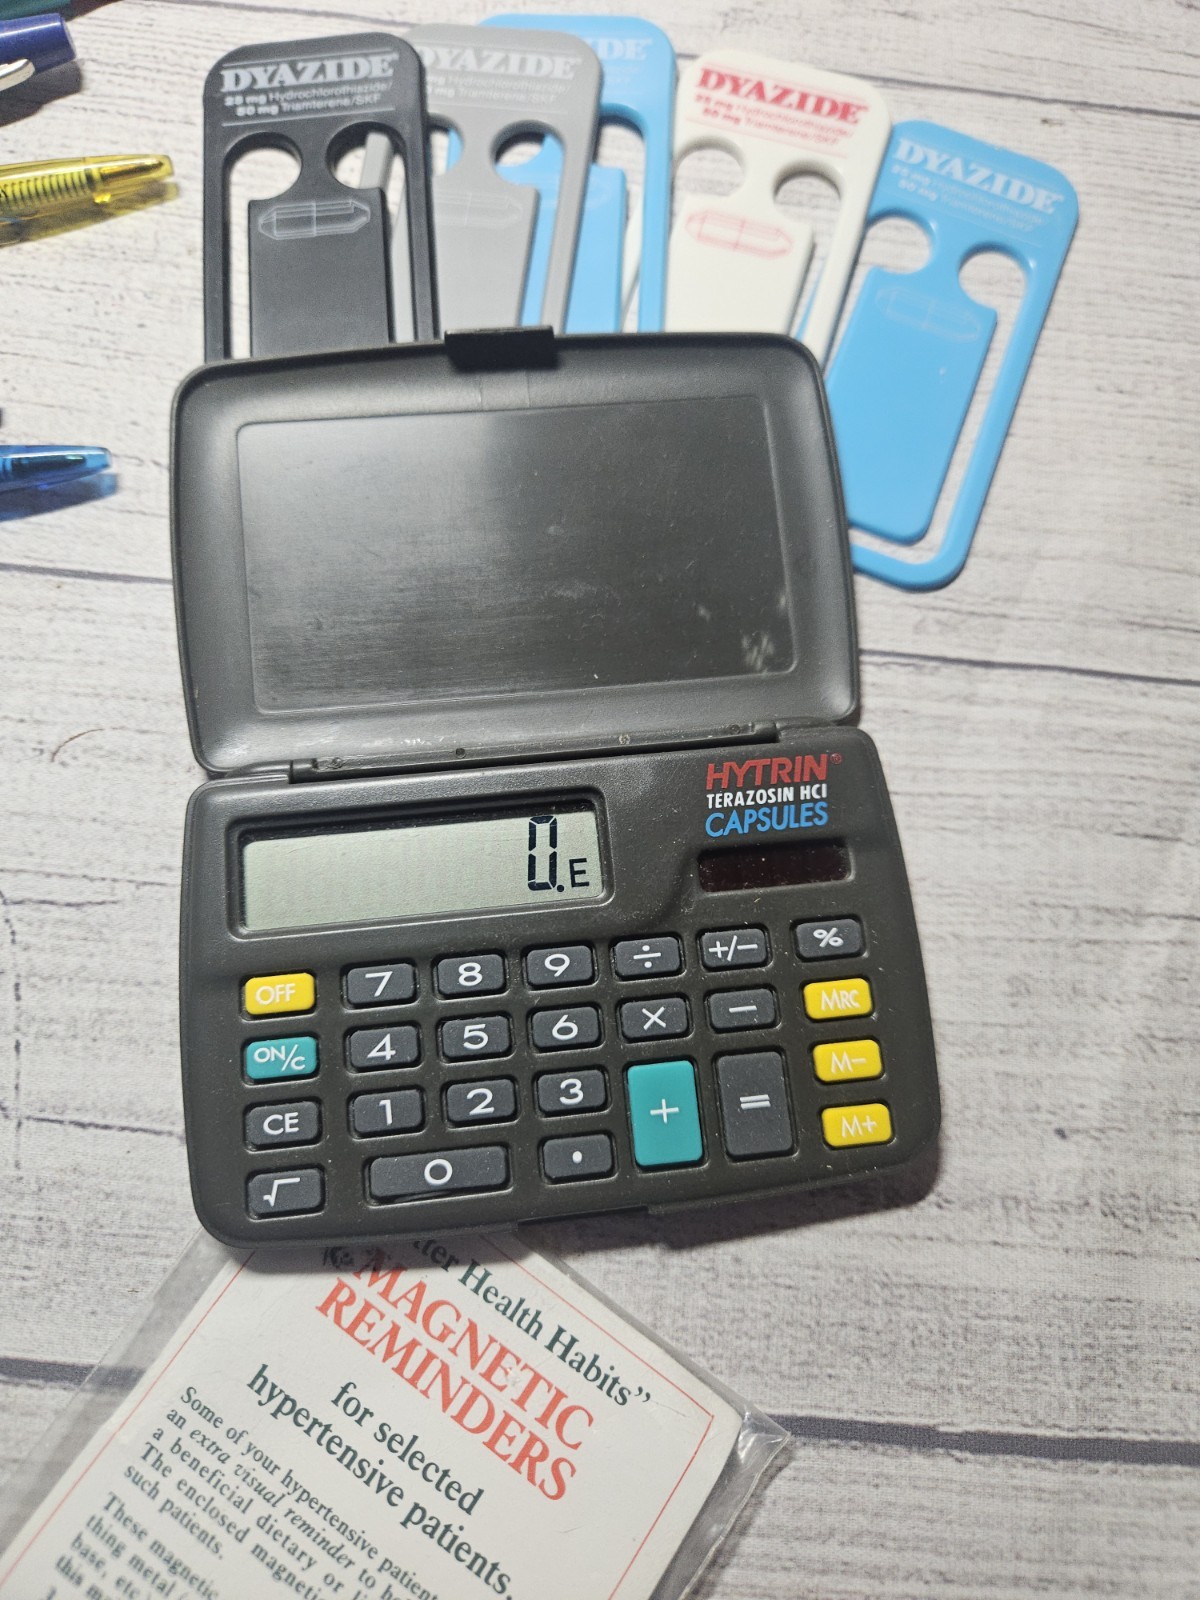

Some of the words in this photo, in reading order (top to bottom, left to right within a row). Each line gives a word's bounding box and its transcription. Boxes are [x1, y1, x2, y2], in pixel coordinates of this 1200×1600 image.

[220, 53, 397, 92] DYAZIDE
[696, 68, 869, 125] DYAZIDE
[894, 139, 1064, 214] DYAZIDE
[706, 786, 794, 809] TERAZOSIN
[705, 801, 828, 837] CAPSULES
[812, 927, 844, 948] %
[458, 962, 483, 986] 8
[544, 953, 570, 977] 9
[255, 983, 296, 1005] OFF
[365, 971, 393, 996] 7
[820, 988, 861, 1011] MRC
[463, 1024, 489, 1049] 5
[551, 1014, 578, 1040] 6
[253, 1044, 306, 1071] ON/C
[367, 1034, 396, 1060] 4
[830, 1051, 867, 1074] M-
[466, 1088, 495, 1115] 2
[559, 1078, 584, 1104] 3
[263, 1112, 299, 1135] CE
[379, 1100, 393, 1125] 1
[841, 1115, 877, 1138] M+
[458, 1259, 544, 1341] Health
[352, 1247, 594, 1451] MAGNETIC
[315, 1277, 577, 1501] REMINDERS
[330, 1381, 376, 1427] for
[373, 1420, 485, 1516] selected
[180, 1386, 224, 1429] Some
[226, 1426, 249, 1446] of
[241, 1441, 281, 1477] your
[280, 1469, 379, 1560] hypertensive
[247, 1363, 407, 1508] hypertensive
[400, 1501, 512, 1600] patients.
[141, 1441, 173, 1478] The
[176, 1477, 251, 1544] enclosed
[166, 1408, 188, 1430] an
[190, 1429, 232, 1465] extra
[233, 1463, 287, 1509] visual
[283, 1508, 356, 1570] reminder
[358, 1567, 376, 1589] to
[102, 1491, 149, 1541] These
[124, 1465, 161, 1500] such
[158, 1498, 224, 1560] patients.
[152, 1427, 165, 1442] a
[170, 1437, 255, 1515] beneficial
[256, 1513, 318, 1571] dietary
[323, 1572, 345, 1593] or
[85, 1514, 127, 1559] thing
[128, 1553, 177, 1598] metal
[55, 1555, 83, 1587] this
